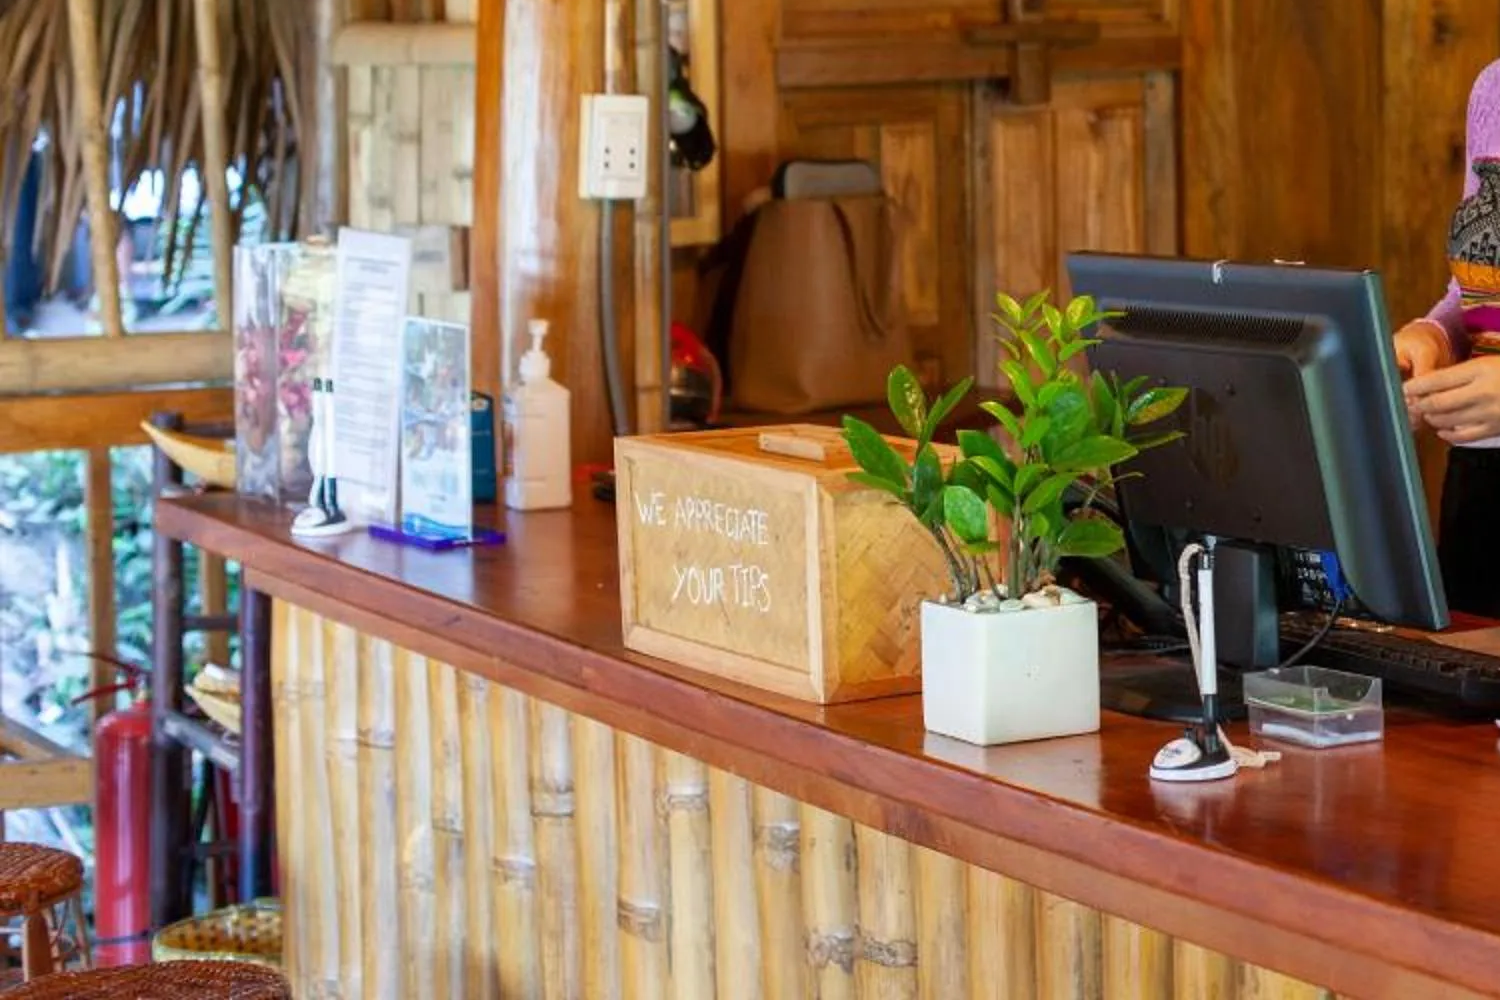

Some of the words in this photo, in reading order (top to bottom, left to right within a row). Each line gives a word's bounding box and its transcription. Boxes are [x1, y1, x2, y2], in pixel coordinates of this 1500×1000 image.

[633, 489, 666, 526] WE
[674, 495, 769, 546] APPRECIATE
[671, 564, 725, 605] YOUR
[728, 563, 771, 612] TIPS
